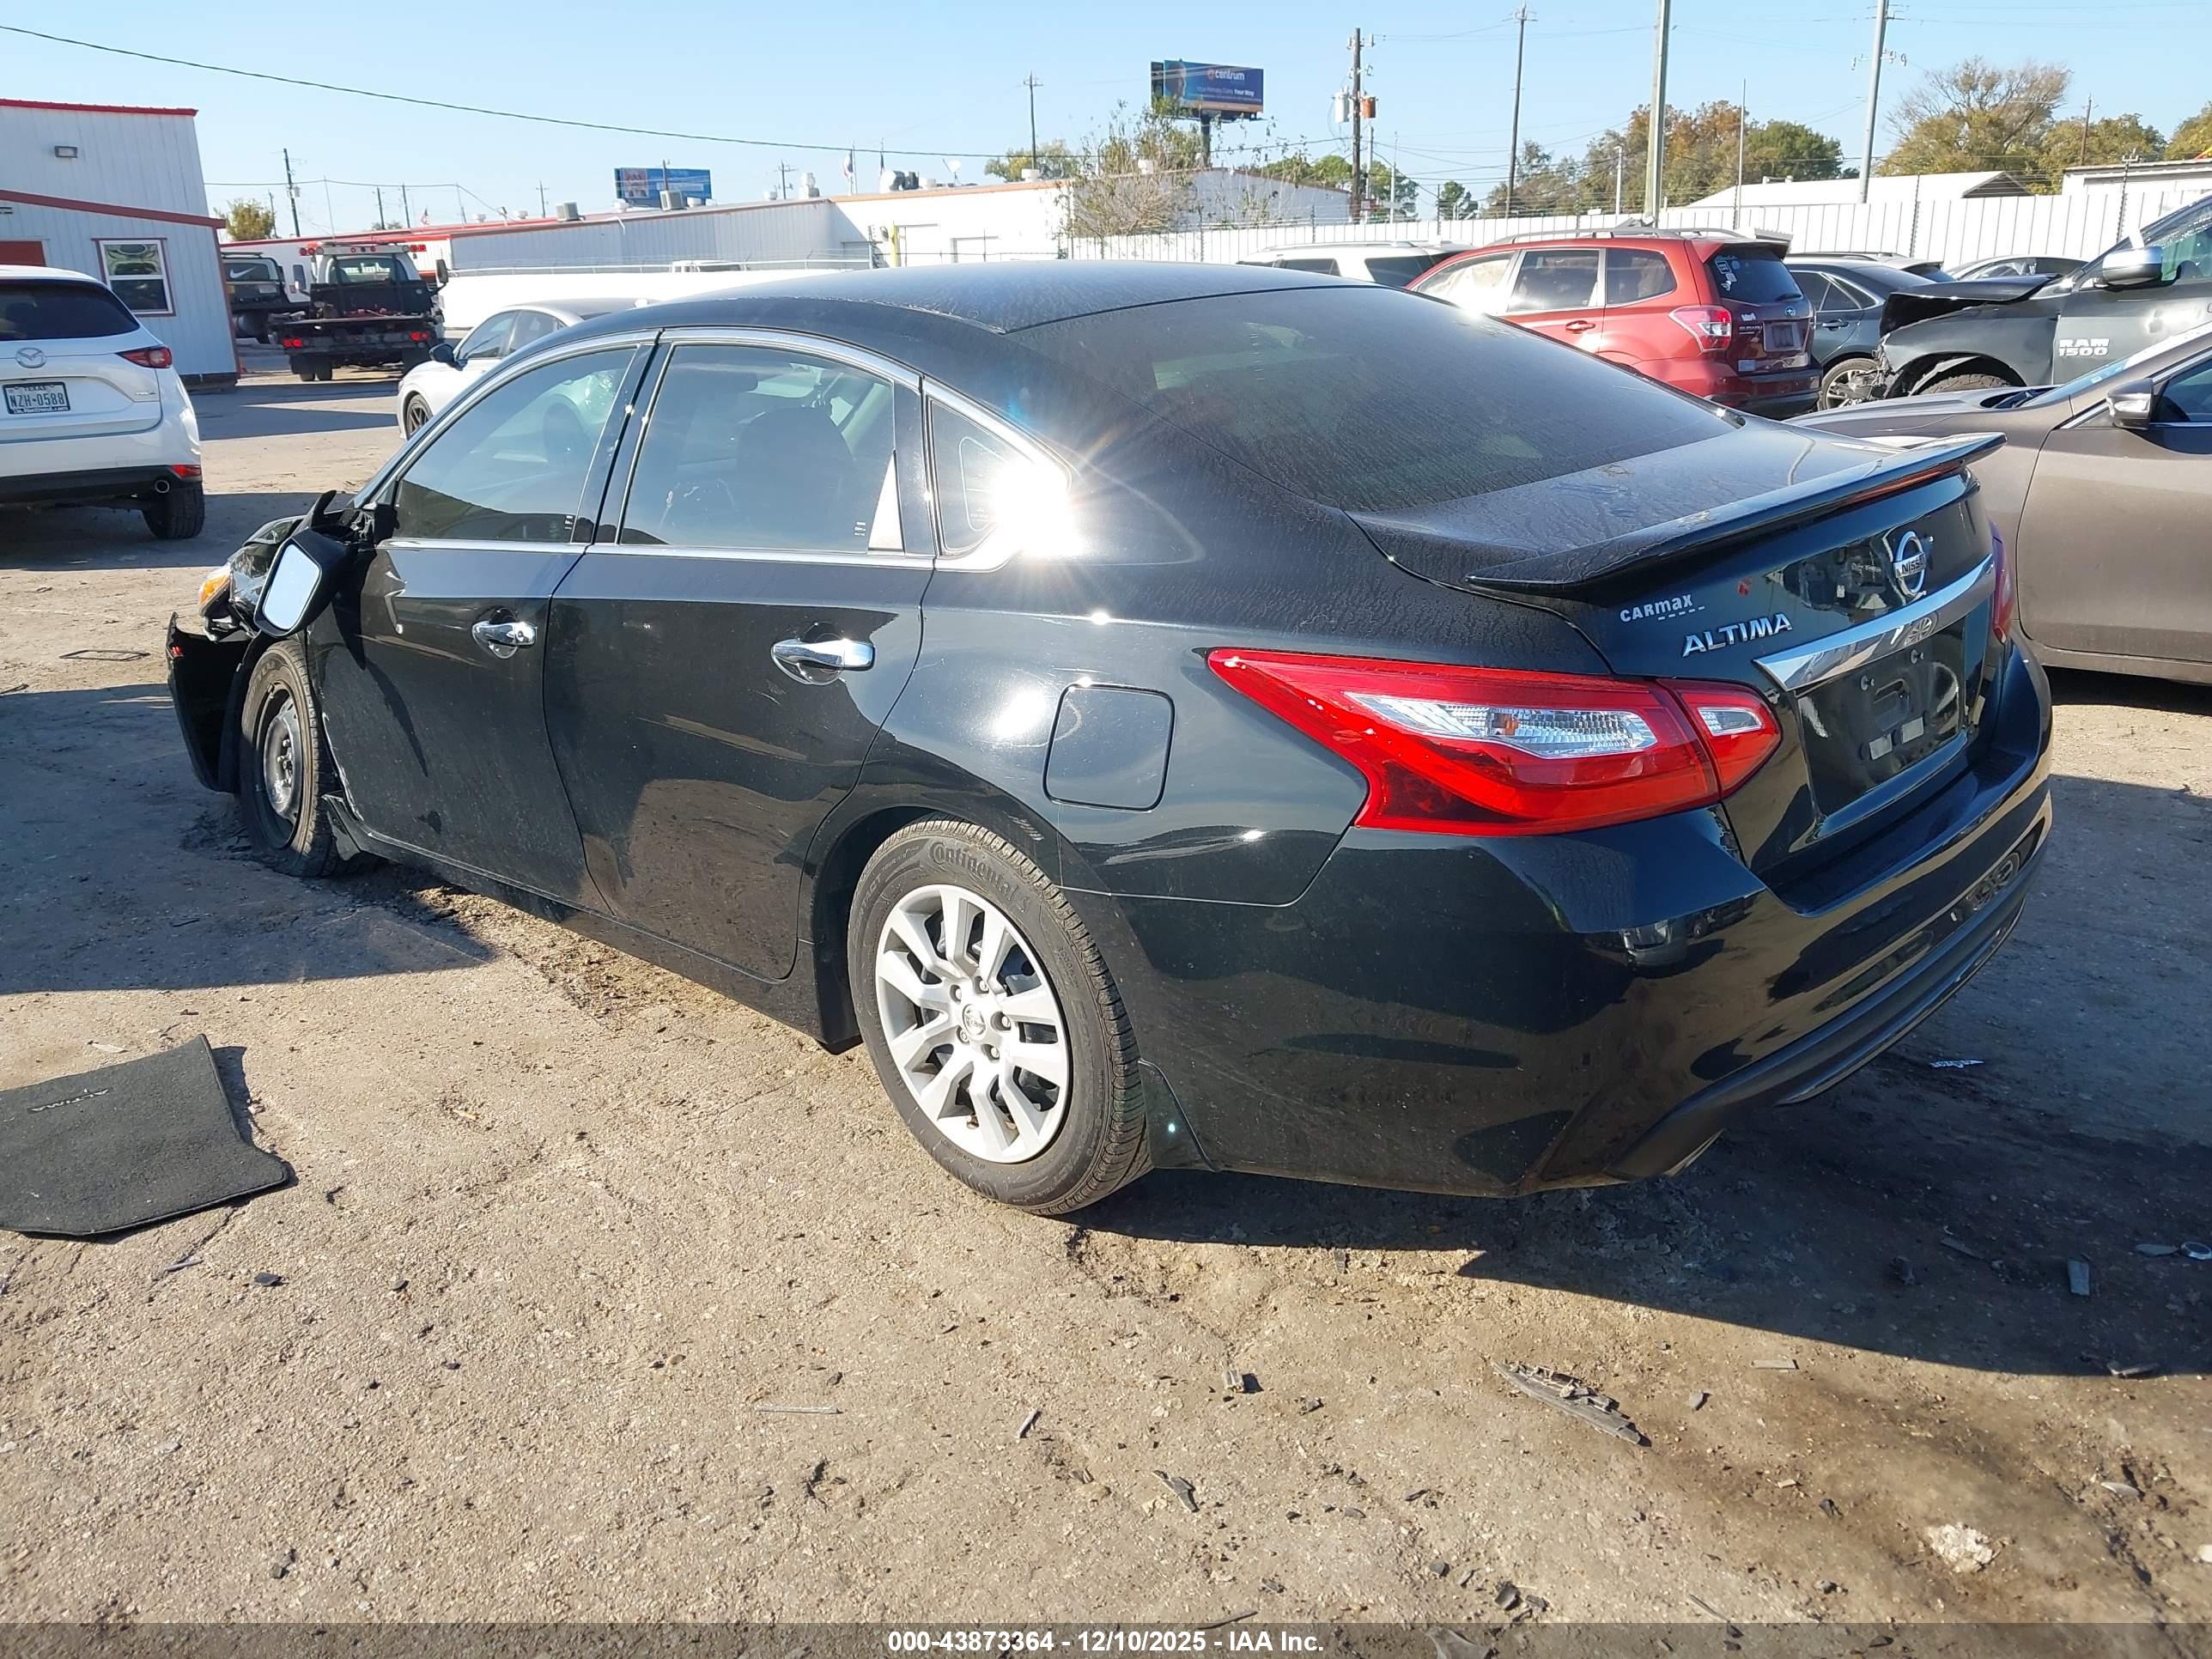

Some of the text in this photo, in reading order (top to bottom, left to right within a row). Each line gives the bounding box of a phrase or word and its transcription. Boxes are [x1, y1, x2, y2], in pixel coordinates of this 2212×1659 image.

[2058, 347, 2109, 356] 1500
[2059, 338, 2110, 348] RAM
[1681, 612, 1793, 658] ALTIMA
[929, 842, 1019, 901] Continental
